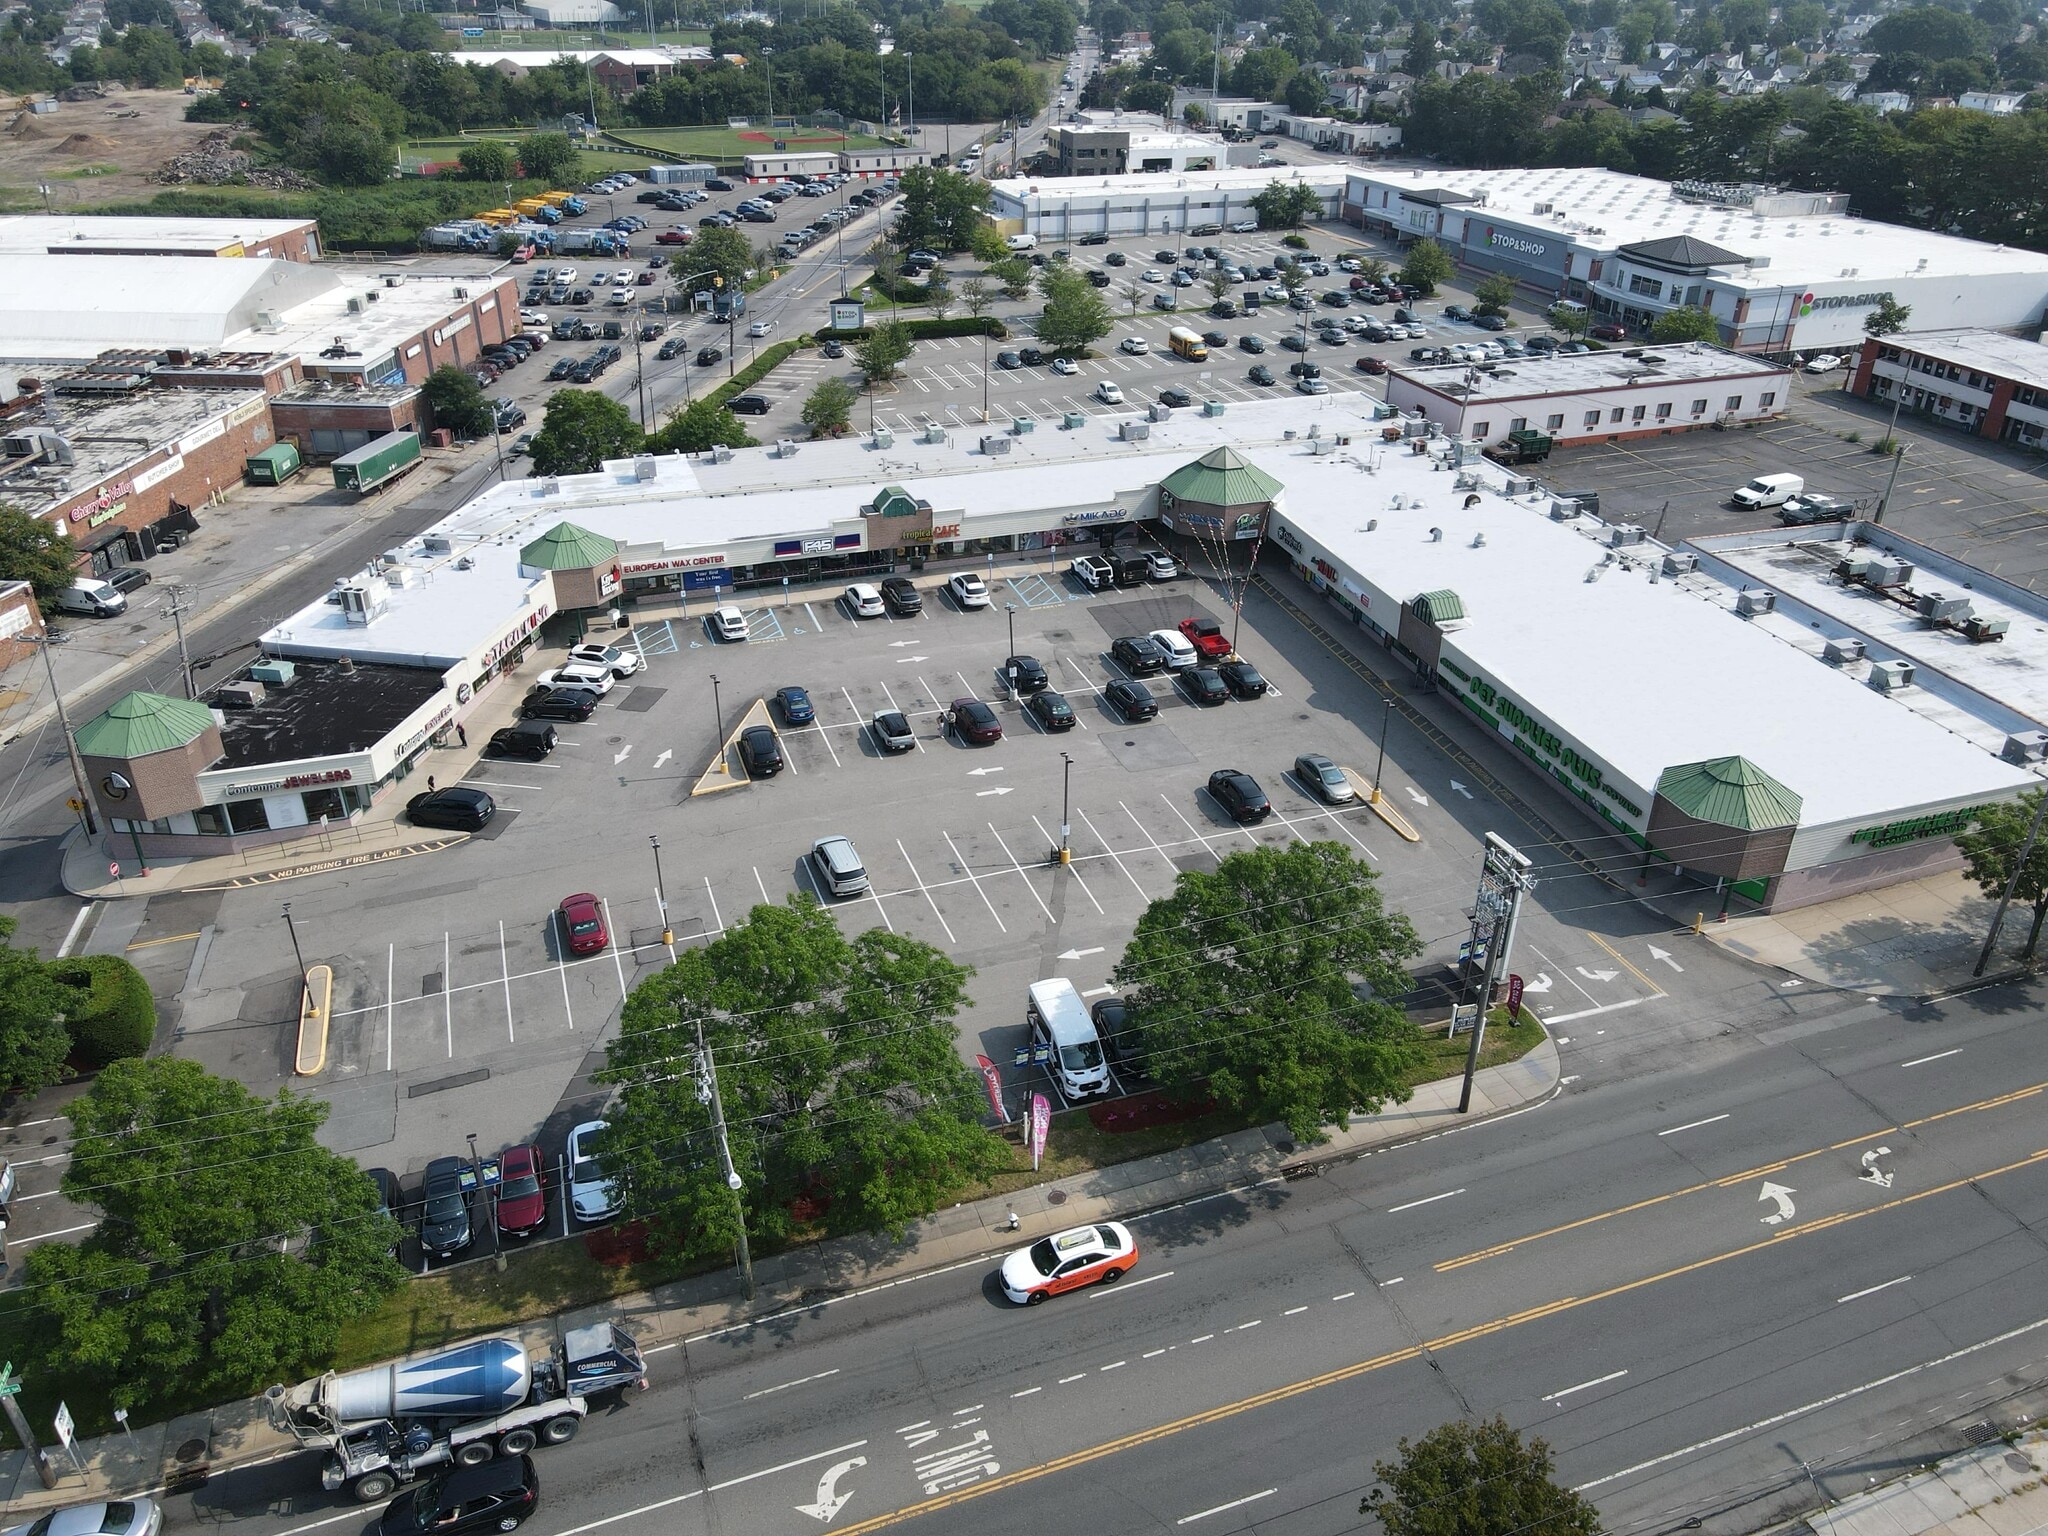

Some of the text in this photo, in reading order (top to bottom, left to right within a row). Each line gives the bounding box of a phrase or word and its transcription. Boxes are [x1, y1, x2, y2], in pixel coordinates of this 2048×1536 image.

[147, 459, 180, 482] BUTCHER SHOP
[71, 481, 134, 521] Cherry Valley
[1080, 508, 1127, 520] MIKADO
[933, 524, 960, 538] CAFE
[803, 538, 833, 554] F45
[623, 555, 725, 574] EUROPEAN WAX CENTER
[491, 603, 550, 658] TACO KING
[1469, 676, 1602, 790] PET SUPPLIES PLUS
[224, 769, 352, 797] Contempo JEWELERS
[277, 848, 402, 878] NO PARKING FIRE LANE
[577, 1360, 617, 1371] COMMERCIAL
